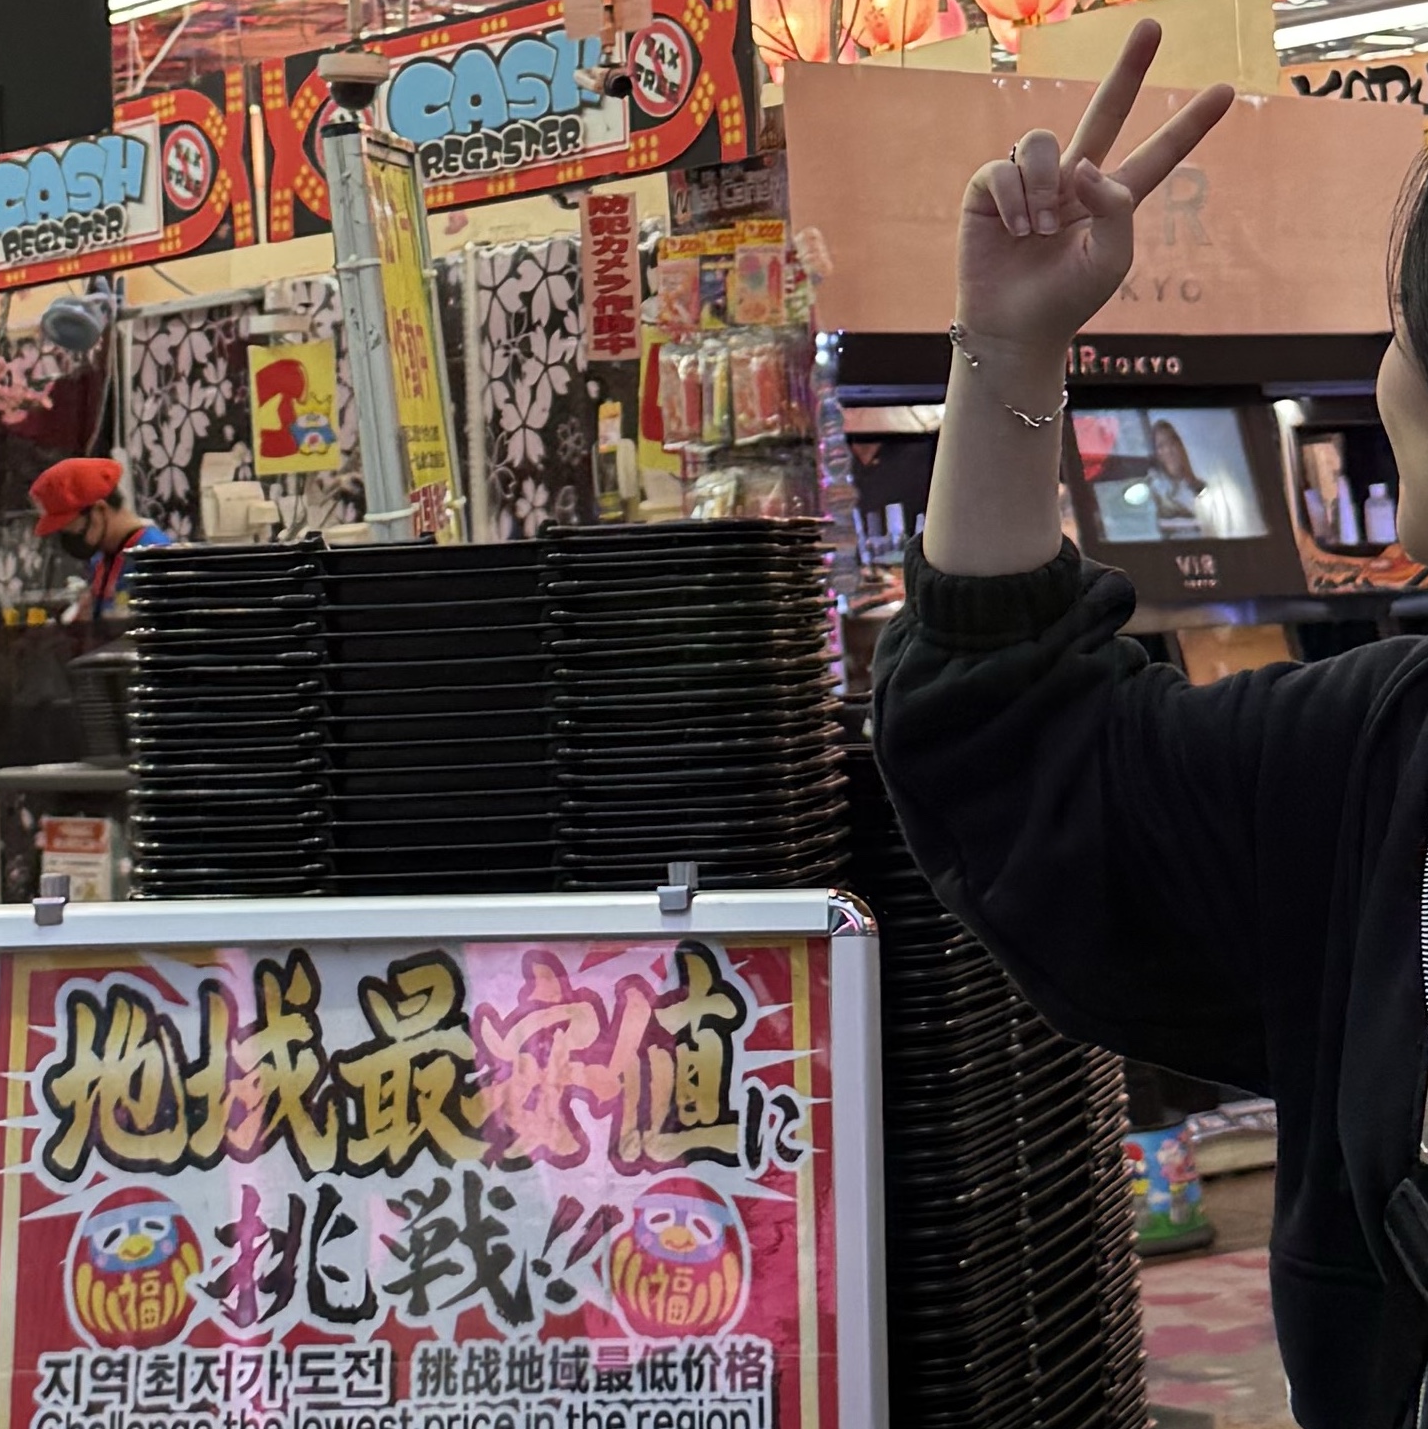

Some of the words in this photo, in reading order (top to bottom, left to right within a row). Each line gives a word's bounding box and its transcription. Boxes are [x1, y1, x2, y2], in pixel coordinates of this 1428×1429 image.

[387, 25, 604, 145] CASH
[418, 115, 582, 181] REGISTER
[1, 202, 128, 264] REGISTER
[1100, 356, 1183, 375] TOKYO
[42, 940, 806, 1176] 地域最安値に
[118, 1277, 168, 1330] 福
[648, 1273, 696, 1327] 福
[417, 1343, 769, 1398] 挑战地域最低价格
